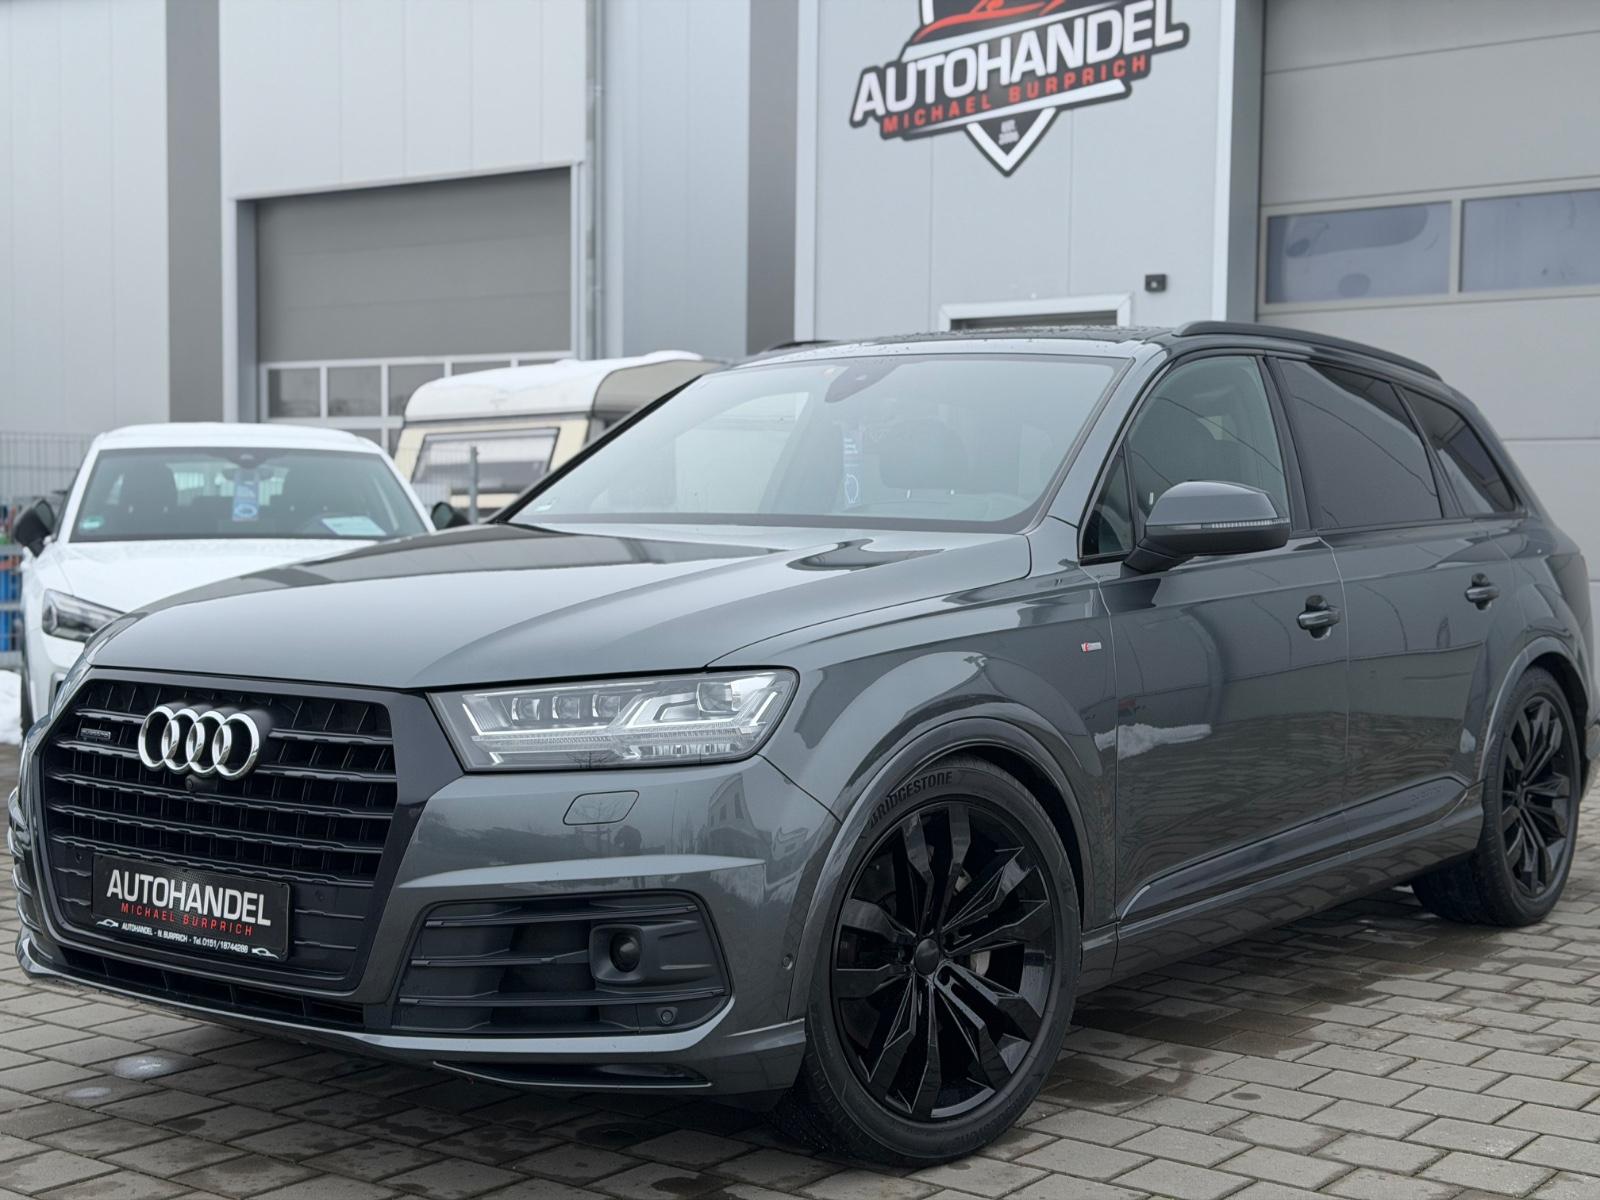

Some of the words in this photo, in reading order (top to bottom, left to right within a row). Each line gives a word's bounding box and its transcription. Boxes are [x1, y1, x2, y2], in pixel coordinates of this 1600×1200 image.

[853, 0, 1184, 122] AUTOHANDEL
[883, 94, 992, 134] MICHAEL
[1008, 54, 1147, 104] BURPRICH
[867, 771, 952, 830] BRIDGESTONE
[106, 869, 272, 927] AUTOHANDEL
[120, 902, 175, 922] MICHAEL
[182, 914, 253, 937] BURPRICH
[121, 922, 154, 936] AUTOHANDEL
